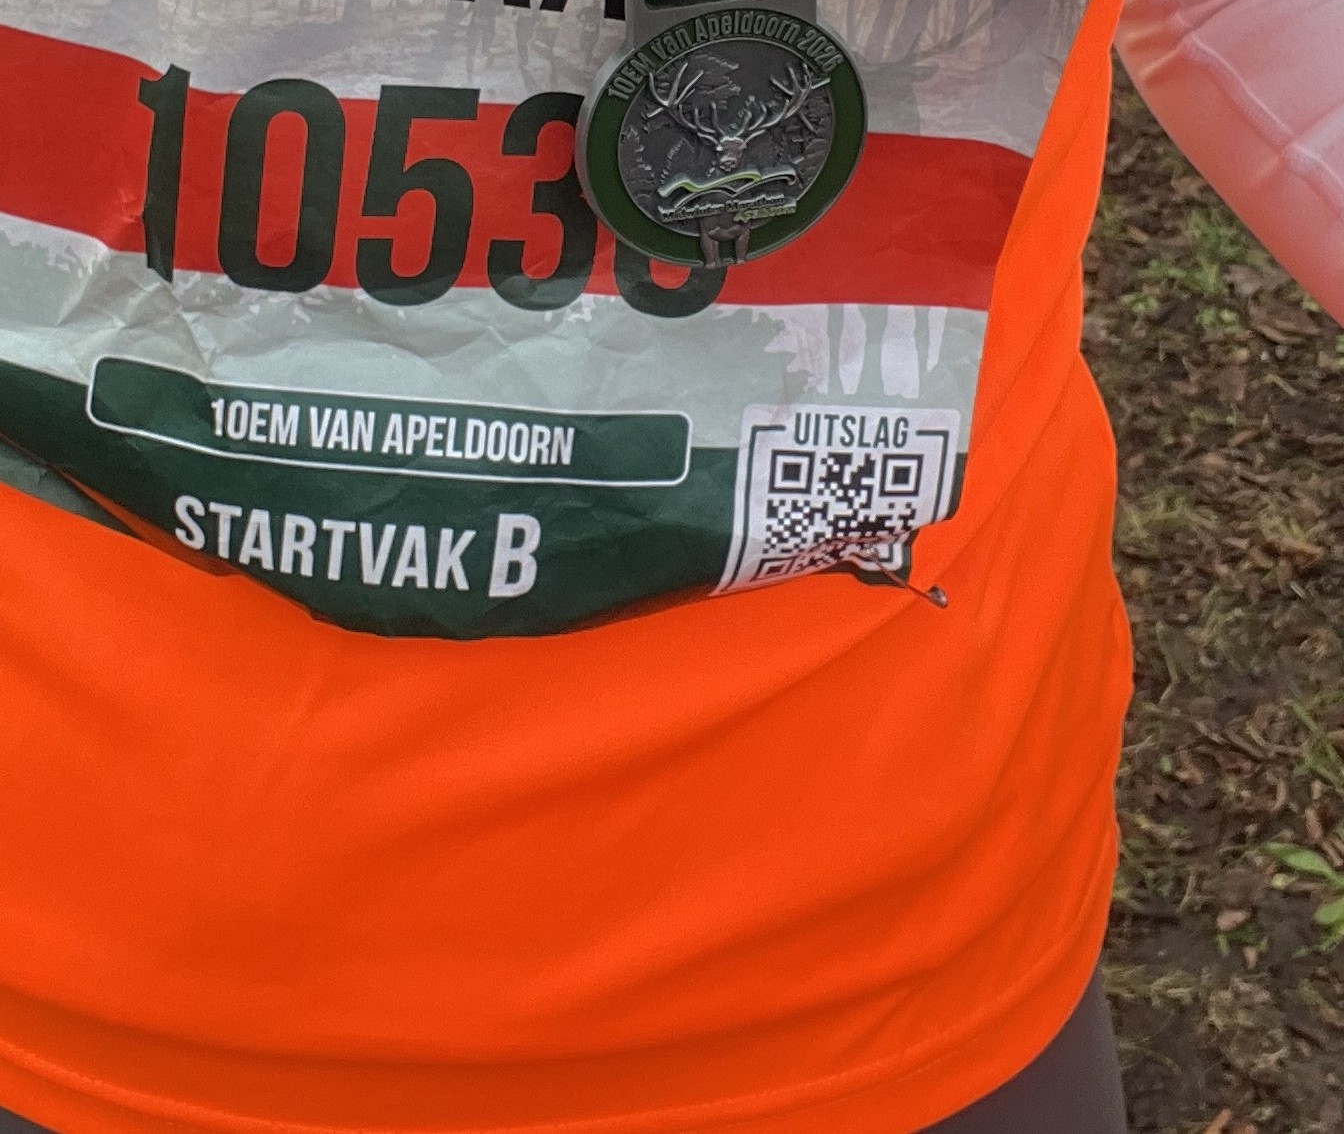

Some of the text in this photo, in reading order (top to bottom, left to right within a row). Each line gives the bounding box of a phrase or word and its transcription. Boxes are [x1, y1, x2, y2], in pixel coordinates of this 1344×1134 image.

[694, 9, 801, 44] Apeldoorn
[796, 28, 845, 74] 2026
[211, 397, 576, 466] 10EM VAN APELDOORN
[793, 412, 910, 449] UITSLAG
[174, 494, 543, 599] STARTVAK B
